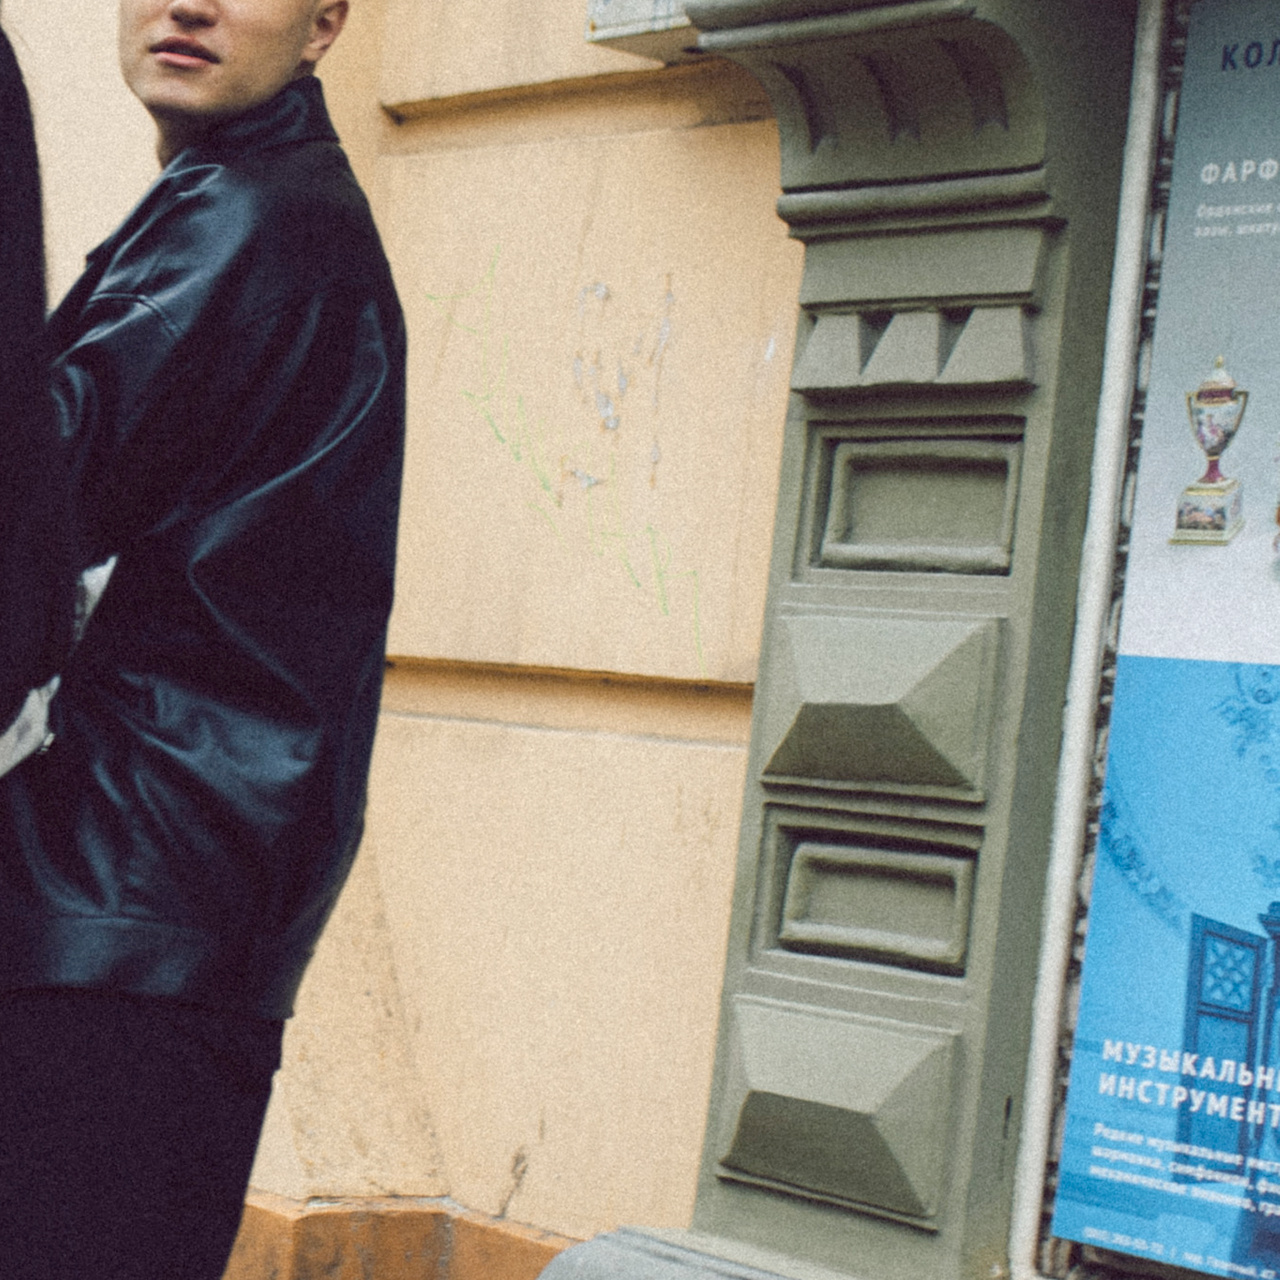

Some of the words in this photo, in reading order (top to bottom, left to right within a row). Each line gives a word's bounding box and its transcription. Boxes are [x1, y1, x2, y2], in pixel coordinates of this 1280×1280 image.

[1221, 39, 1280, 71] КОЛ
[1200, 158, 1279, 185] ФАРФ
[1098, 1073, 1280, 1128] ИНСТРУМЕНТ
